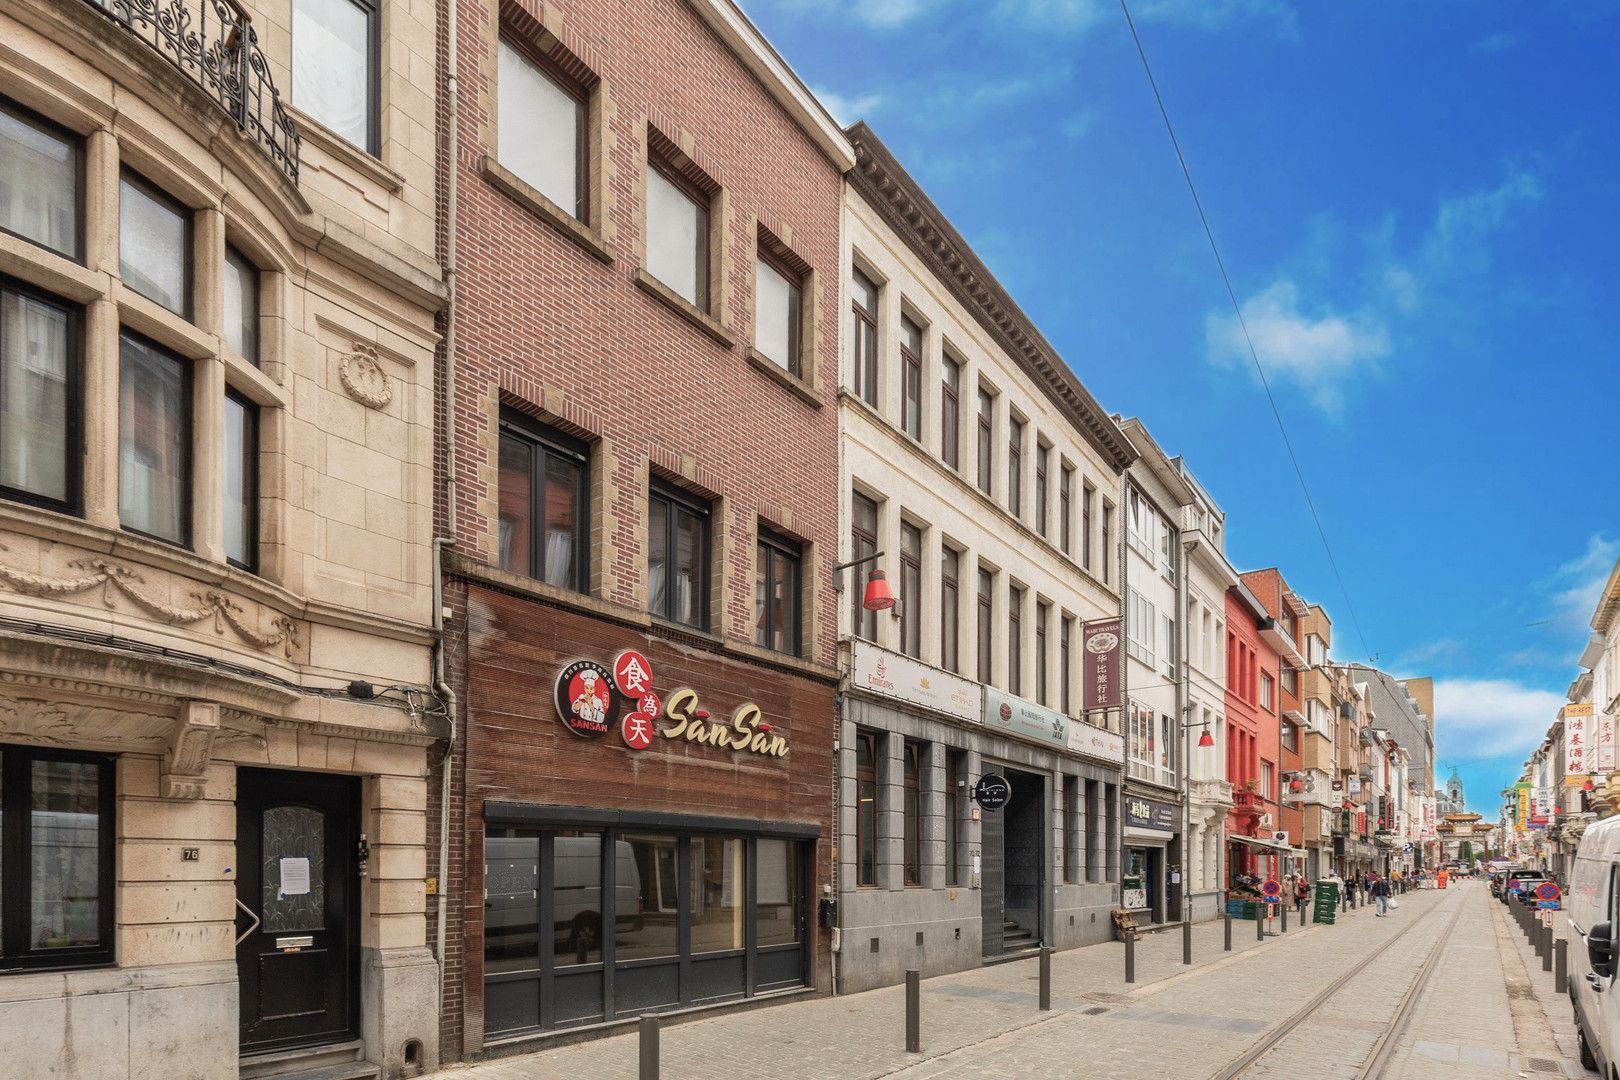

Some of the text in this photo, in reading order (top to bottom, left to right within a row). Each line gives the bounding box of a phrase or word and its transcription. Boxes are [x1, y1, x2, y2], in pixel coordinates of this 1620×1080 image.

[868, 674, 894, 690] Emirates
[570, 718, 608, 732] SANSAN
[185, 850, 198, 860] 76
